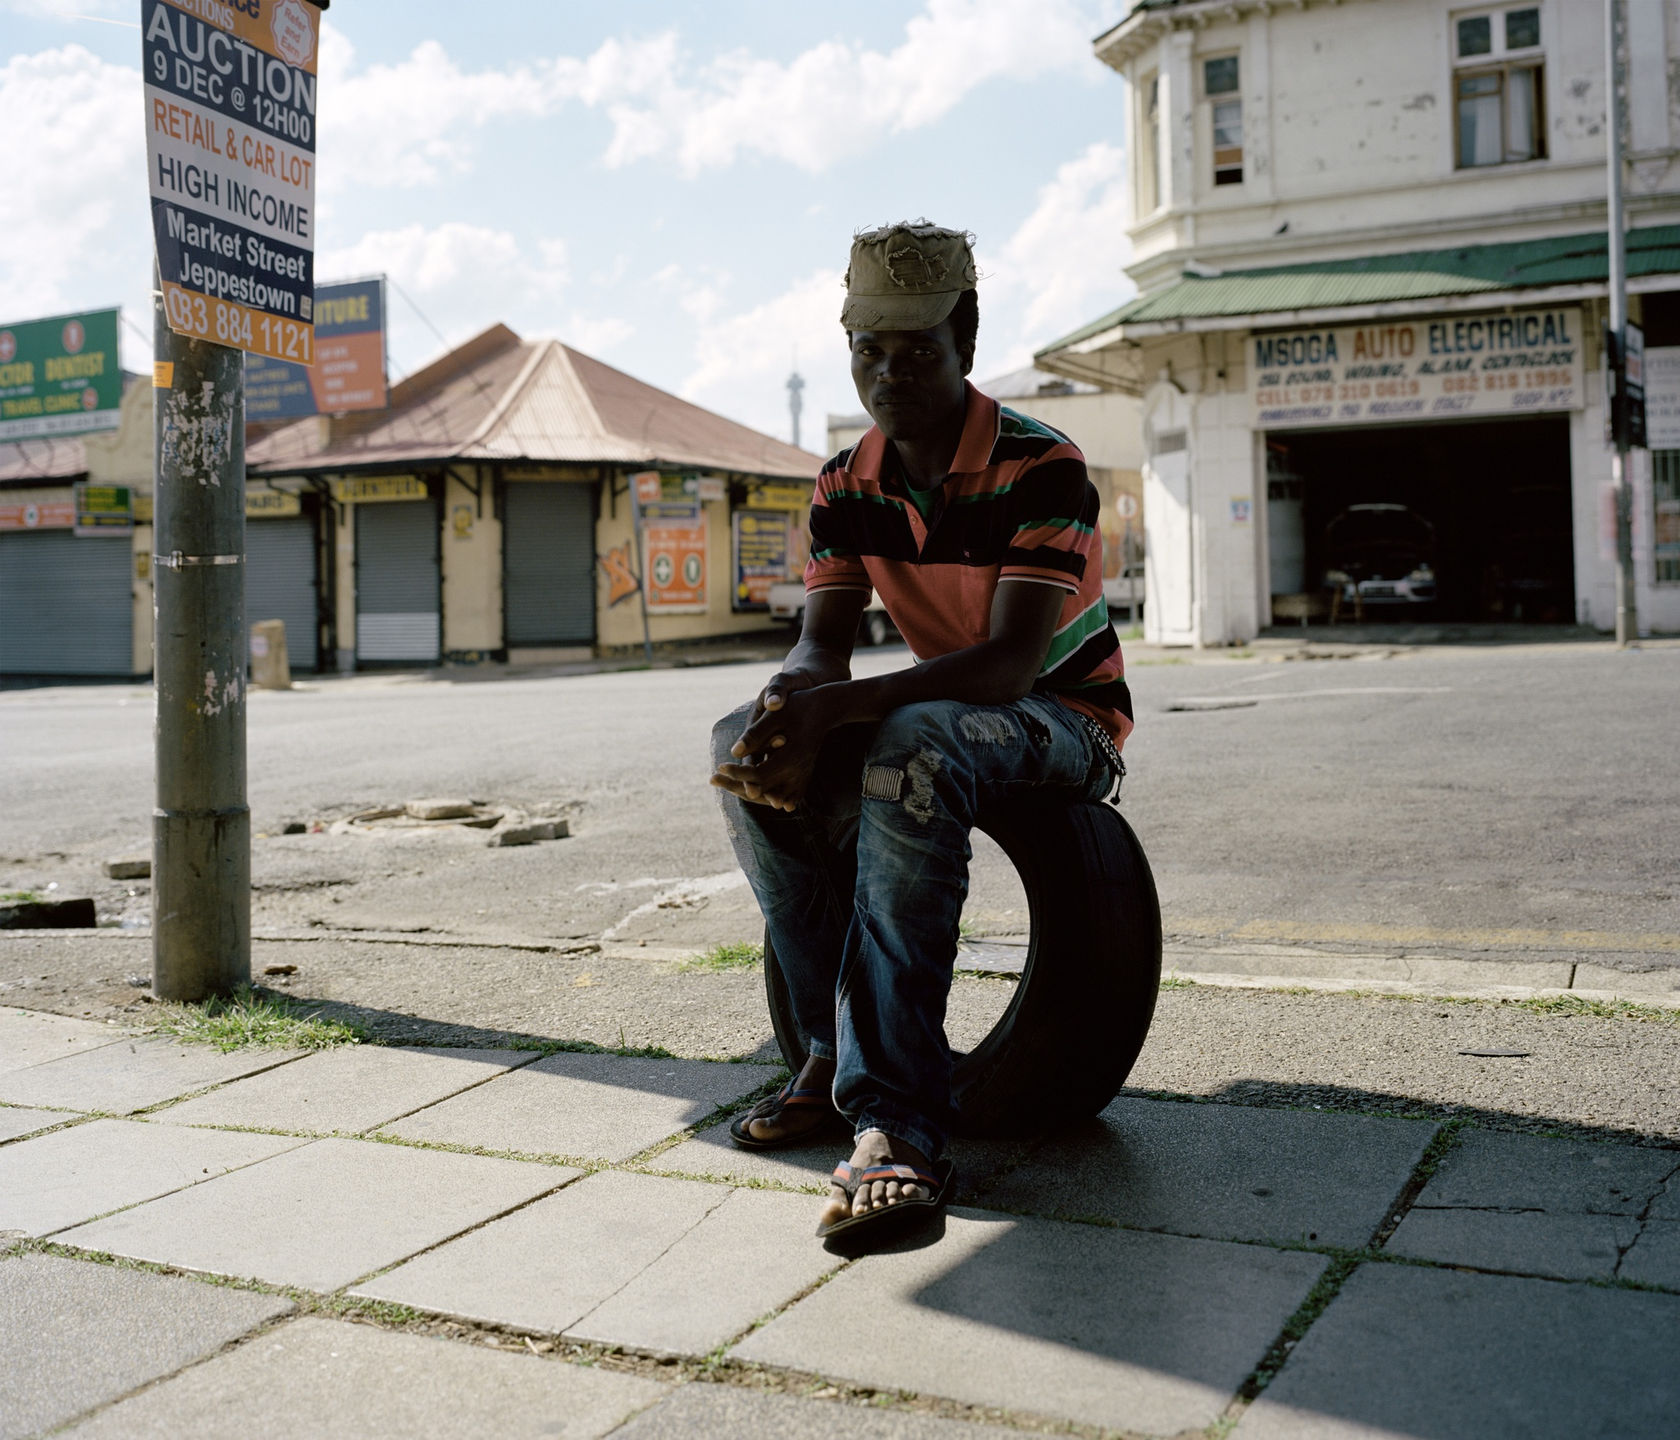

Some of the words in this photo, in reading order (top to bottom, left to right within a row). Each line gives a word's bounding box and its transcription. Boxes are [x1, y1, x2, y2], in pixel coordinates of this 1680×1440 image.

[146, 3, 316, 116] AUCTION
[153, 50, 168, 81] 9
[175, 57, 224, 105] DEC
[231, 86, 246, 112] @
[253, 94, 311, 144] 12H00
[154, 98, 222, 156] RETAIL
[226, 128, 239, 162] &
[242, 135, 276, 178] CAR
[280, 151, 312, 190] LOT
[157, 153, 219, 206] HIGH
[227, 179, 308, 238] INCOME
[166, 207, 242, 261] Market
[246, 237, 306, 282] Street
[180, 252, 295, 314] Jeppestown
[0, 362, 35, 388] CTOR
[45, 351, 104, 382] DENTIST
[215, 303, 254, 347] 884
[260, 317, 310, 361] 1121
[1255, 332, 1338, 369] MSOGA
[1353, 326, 1415, 361] AUTO
[1429, 312, 1571, 354] ELECTRICAL
